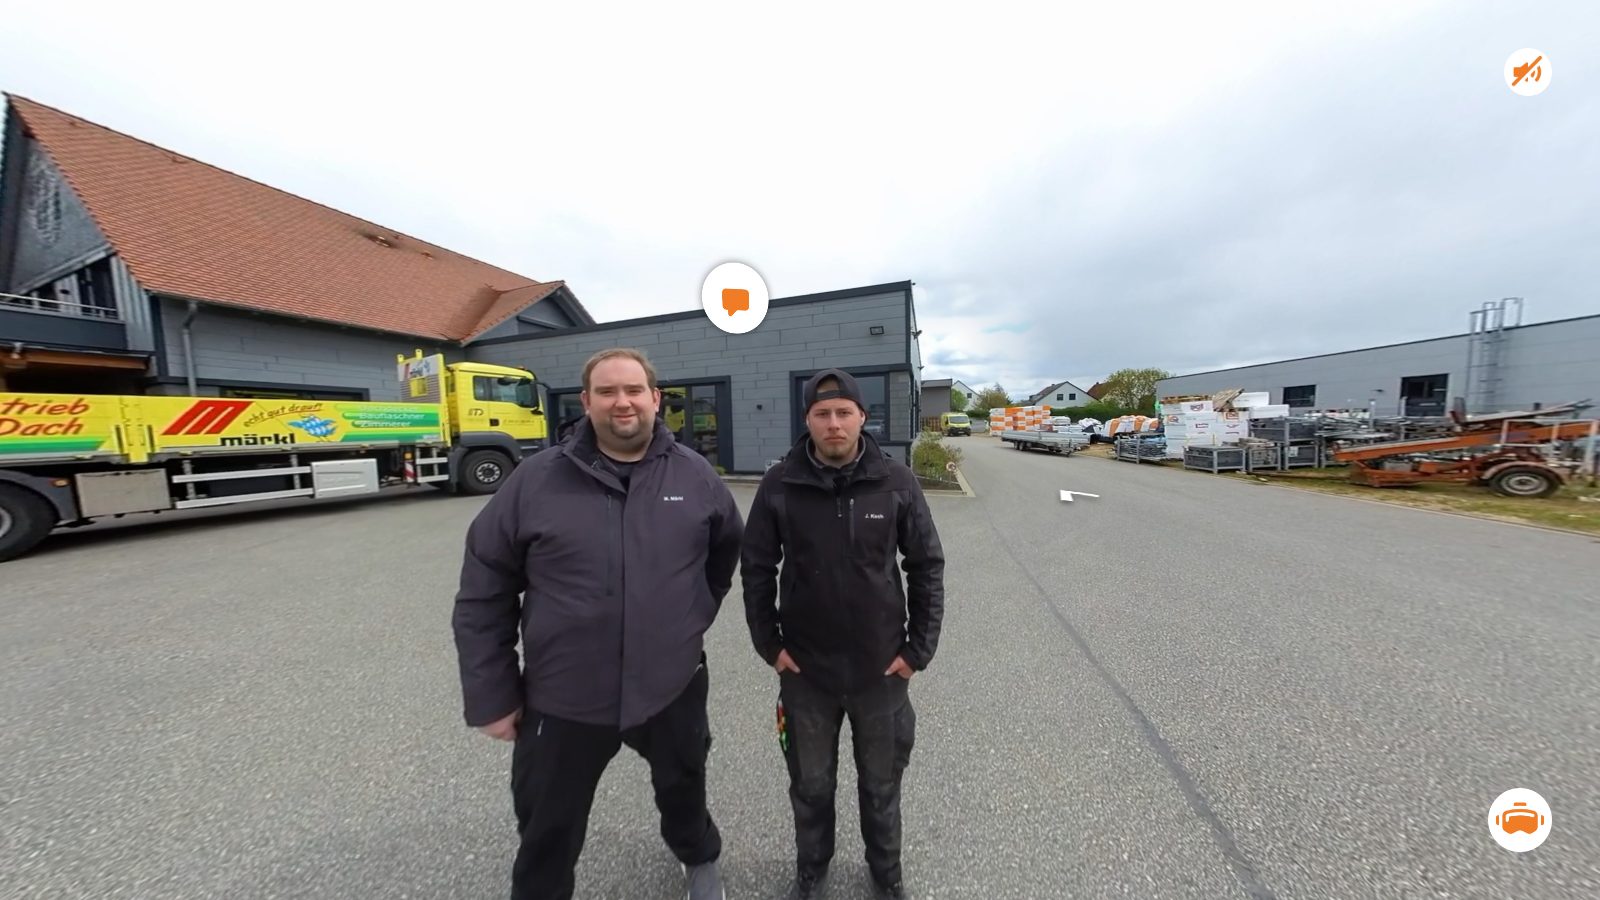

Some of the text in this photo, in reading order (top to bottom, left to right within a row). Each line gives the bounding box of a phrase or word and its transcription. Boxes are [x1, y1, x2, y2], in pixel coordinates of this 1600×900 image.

[243, 412, 265, 427] echt
[267, 406, 285, 418] gut
[0, 417, 84, 436] Dach
[220, 433, 296, 446] märkl
